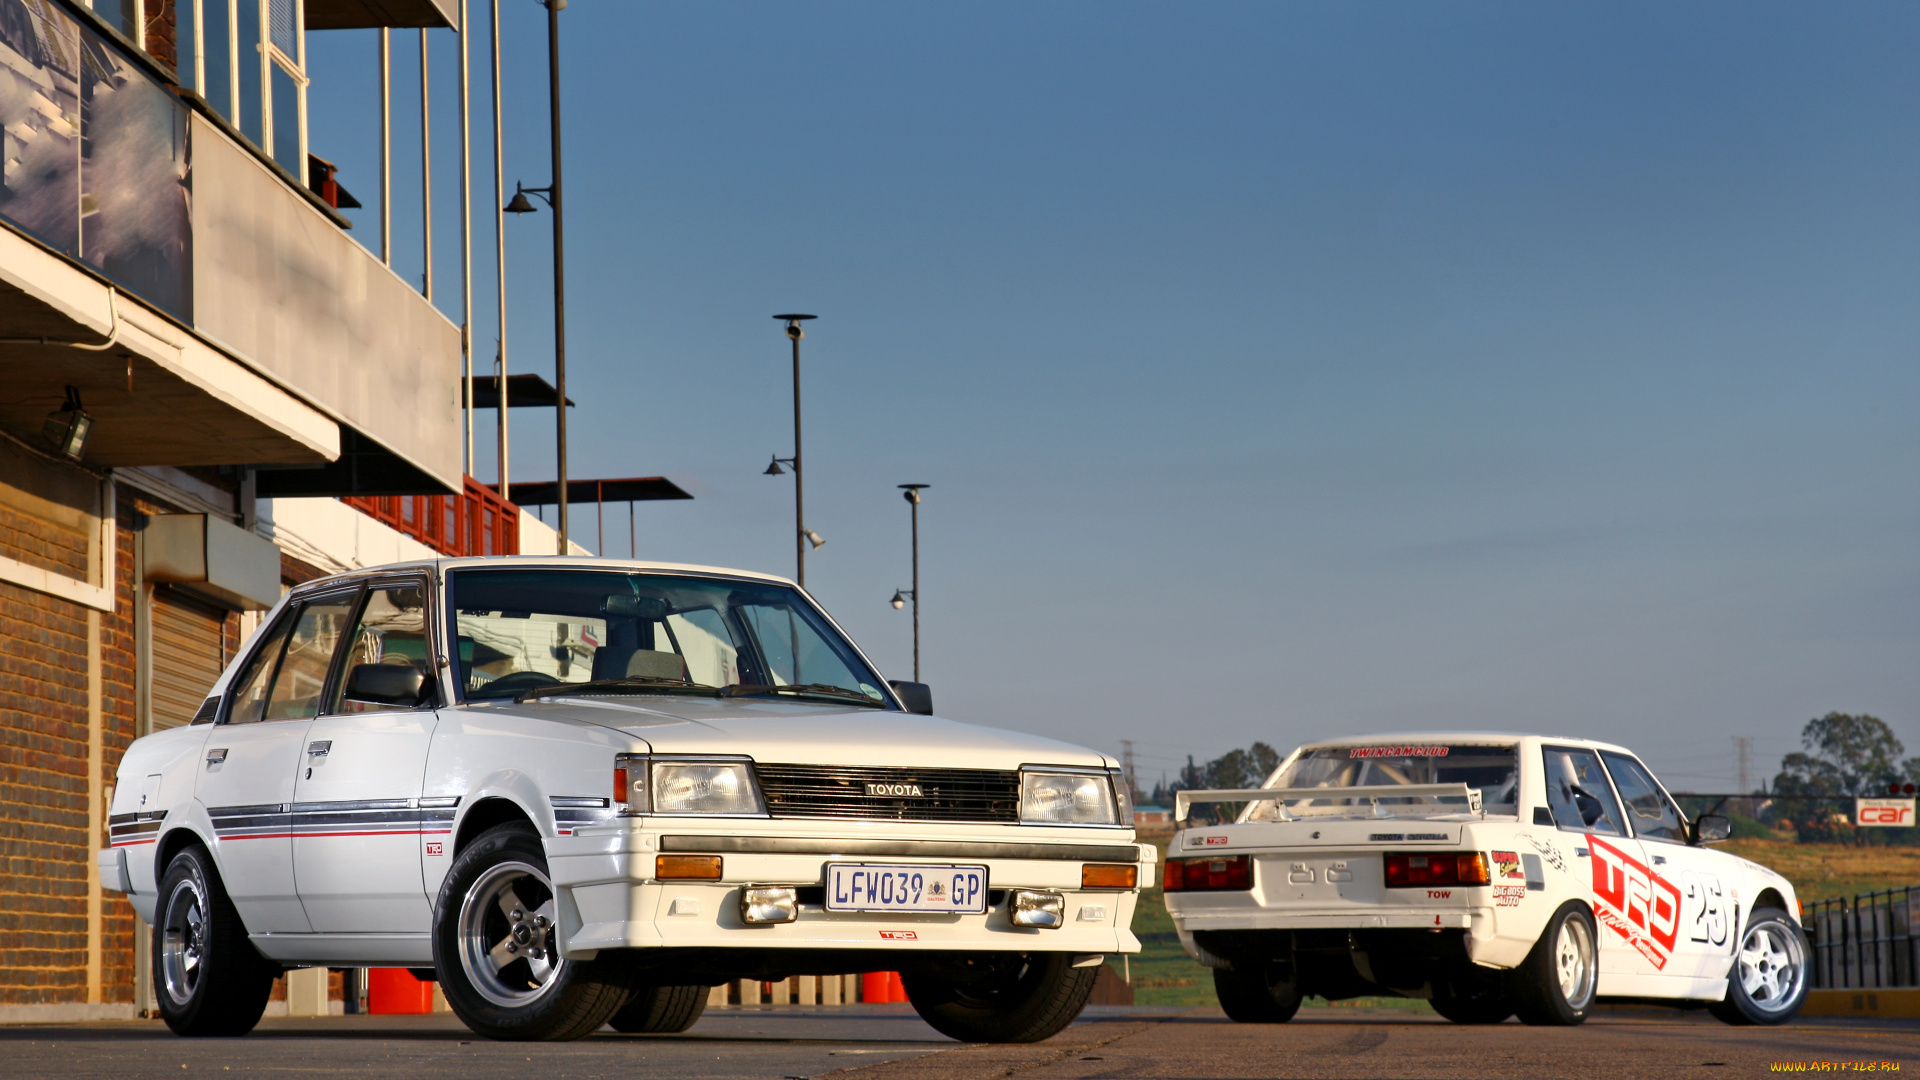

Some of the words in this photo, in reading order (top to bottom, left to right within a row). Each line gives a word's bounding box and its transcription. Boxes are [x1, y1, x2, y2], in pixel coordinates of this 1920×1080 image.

[1350, 747, 1449, 758] TWINCAMCLUB
[867, 784, 922, 796] TOYOTA
[1860, 807, 1912, 823] car
[427, 843, 442, 855] TRD
[835, 871, 923, 904] LFW039
[951, 874, 979, 905] GP
[1427, 890, 1451, 898] TOW
[1507, 886, 1525, 897] BOSS
[1588, 838, 1679, 941] TRD
[1497, 896, 1519, 906] AUTO
[1681, 870, 1727, 946] 25
[880, 931, 918, 941] TRD
